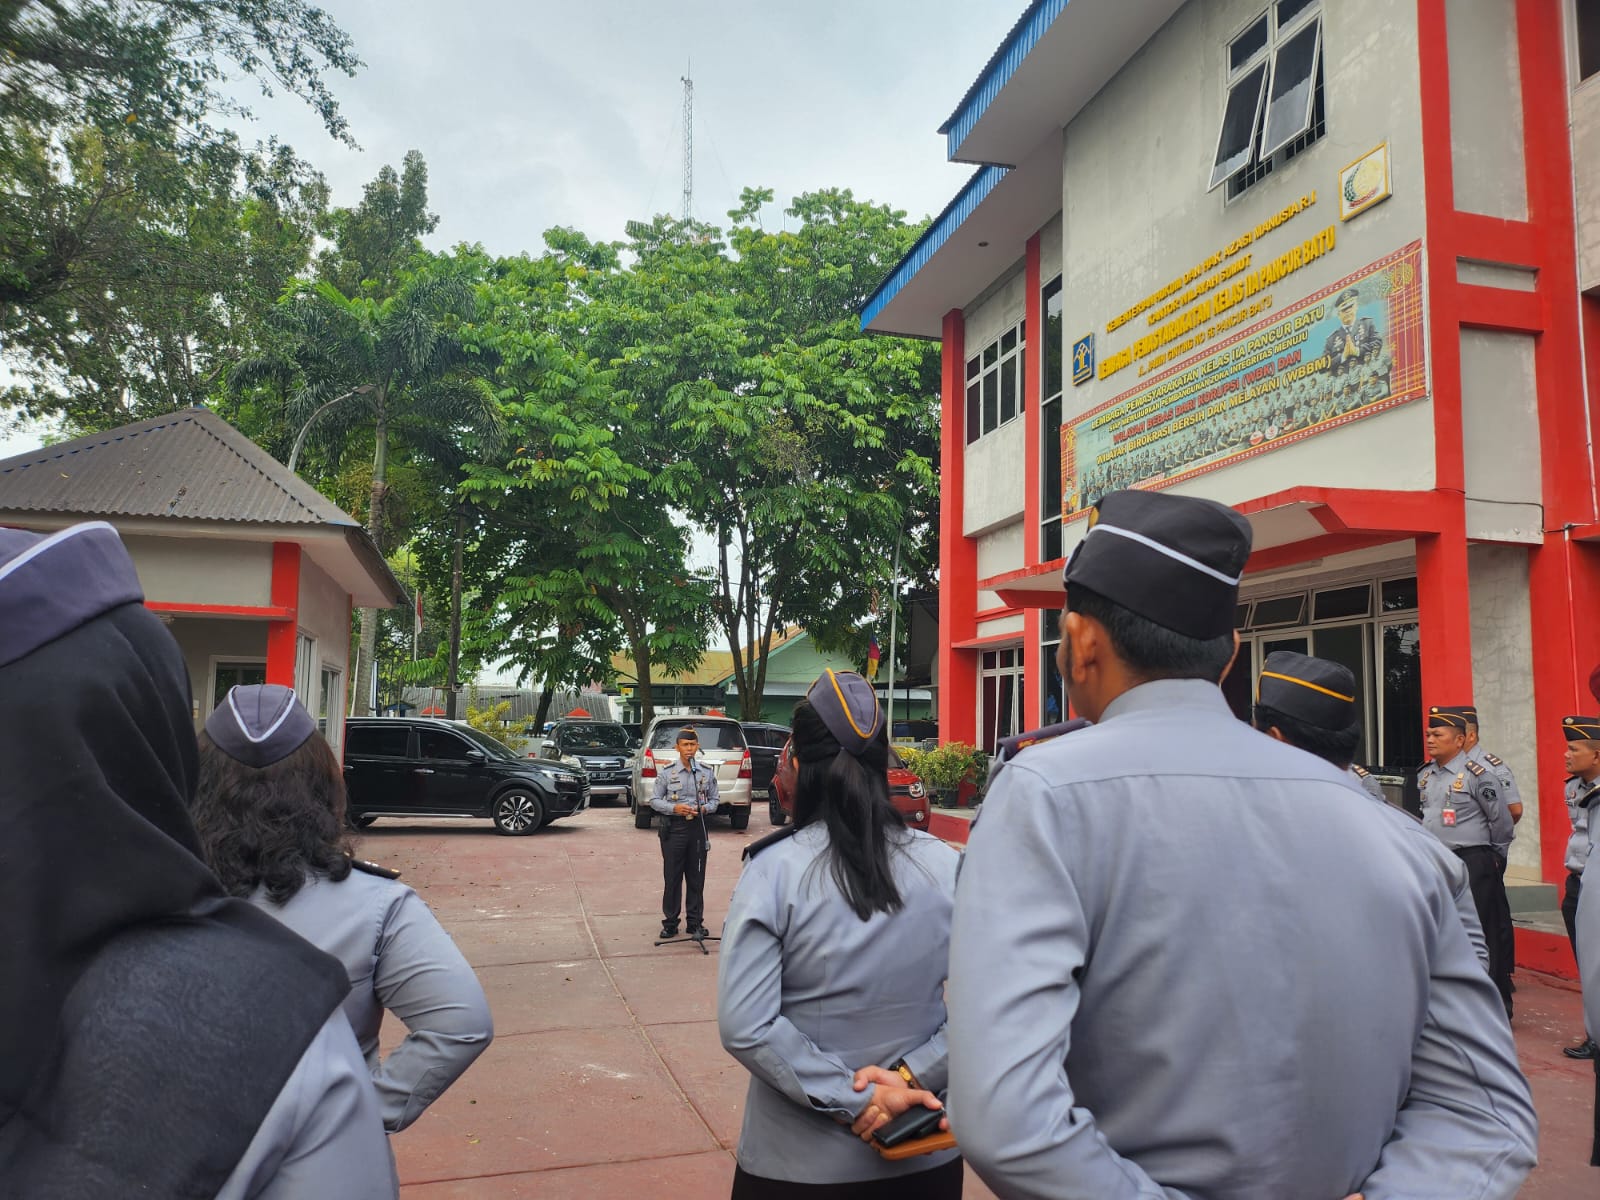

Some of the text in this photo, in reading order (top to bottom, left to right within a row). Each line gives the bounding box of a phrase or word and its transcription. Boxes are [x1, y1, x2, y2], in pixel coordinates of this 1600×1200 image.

[1147, 254, 1252, 326] KANTOR WILAYAH SUMUT
[1183, 264, 1202, 285] DAN
[1203, 251, 1222, 272] HAK
[1224, 231, 1253, 259] AZASI
[1254, 202, 1300, 240] MANUSIA
[1098, 346, 1132, 381] LEMBAGA
[1133, 300, 1211, 361] PEMASYARAKATAN
[1213, 281, 1244, 316] KELAS
[1260, 246, 1302, 289] PANCUR
[1302, 224, 1336, 265] BATU
[1167, 339, 1194, 362] GINTING
[1216, 309, 1248, 334] PANCUR
[1249, 295, 1273, 318] BATU
[1091, 409, 1125, 431] LEMBAGA
[1126, 369, 1199, 413] PEMASYARAKATAN
[1201, 353, 1230, 376] KELAS
[1247, 322, 1291, 353] PANCUR
[1294, 304, 1325, 330] BATU
[1097, 354, 1332, 465] WILAYAH BIROKRASI BERSIH DAN MELAYANI (WBBM)
[1109, 330, 1308, 432] SIAP MEWUJUDKAN PEMBANGUNAN ZONA INTEGRITAS MENUJU
[1113, 349, 1301, 444] WILAYAH BEBAS DARI KORUPSI (WBK) DAN
